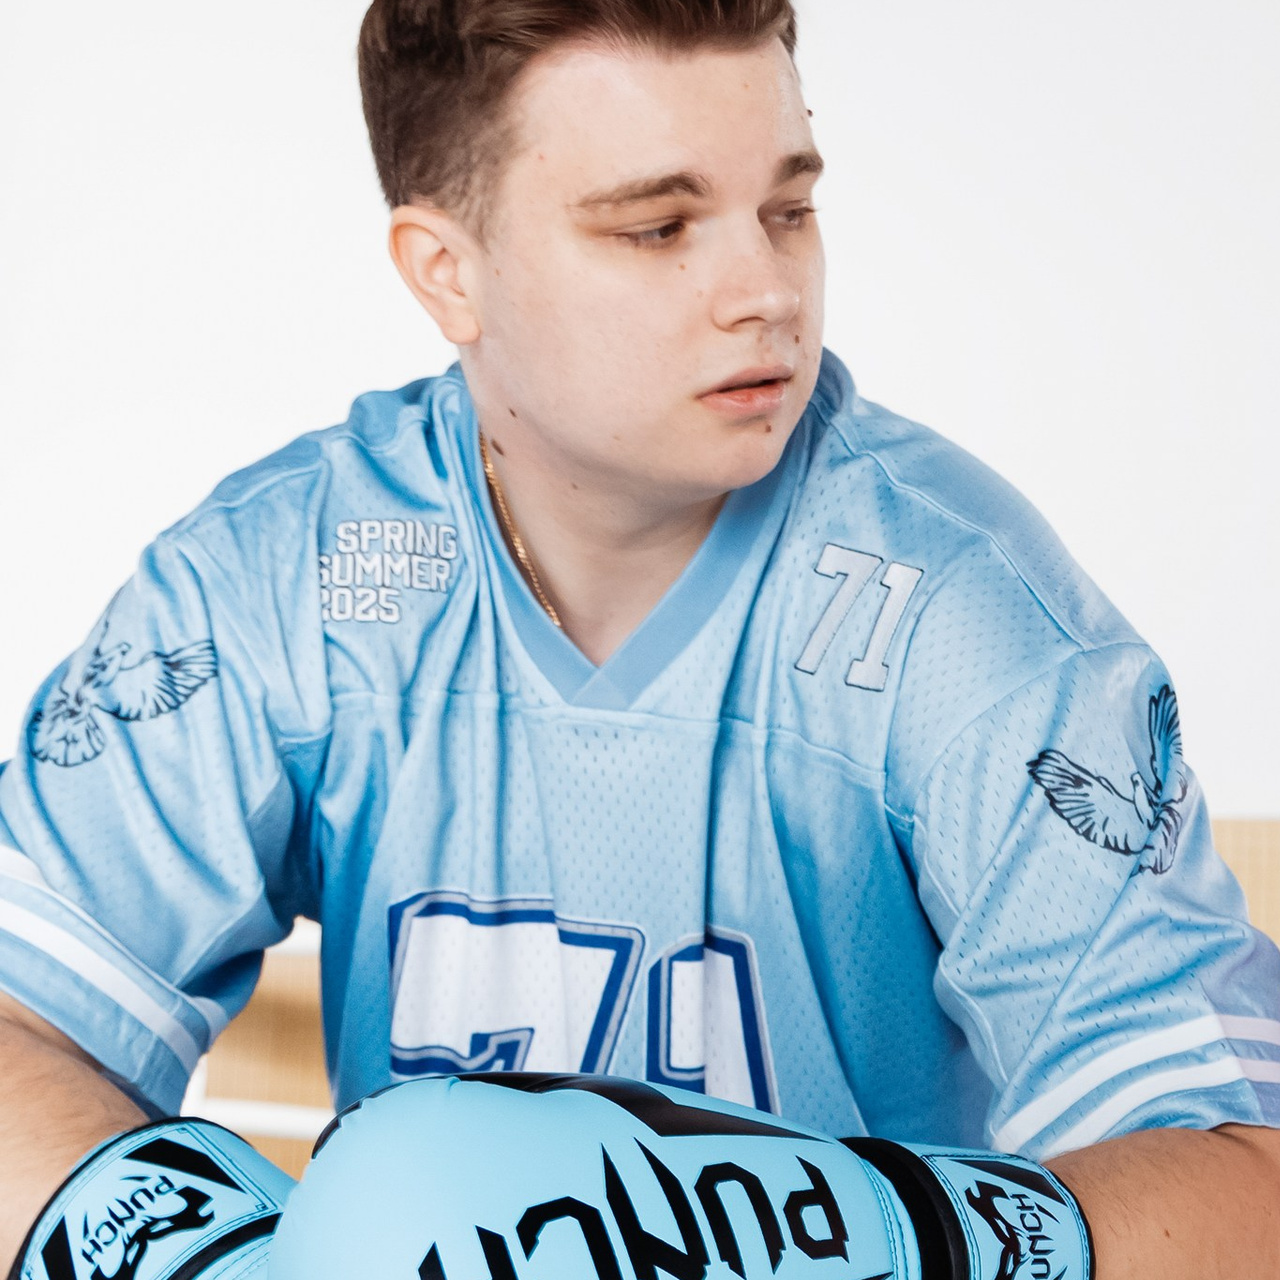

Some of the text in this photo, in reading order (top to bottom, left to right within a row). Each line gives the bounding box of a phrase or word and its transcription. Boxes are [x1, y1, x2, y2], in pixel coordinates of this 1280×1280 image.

[336, 520, 457, 560] SPRING
[794, 542, 925, 692] 71
[81, 1175, 177, 1265] PUNCH
